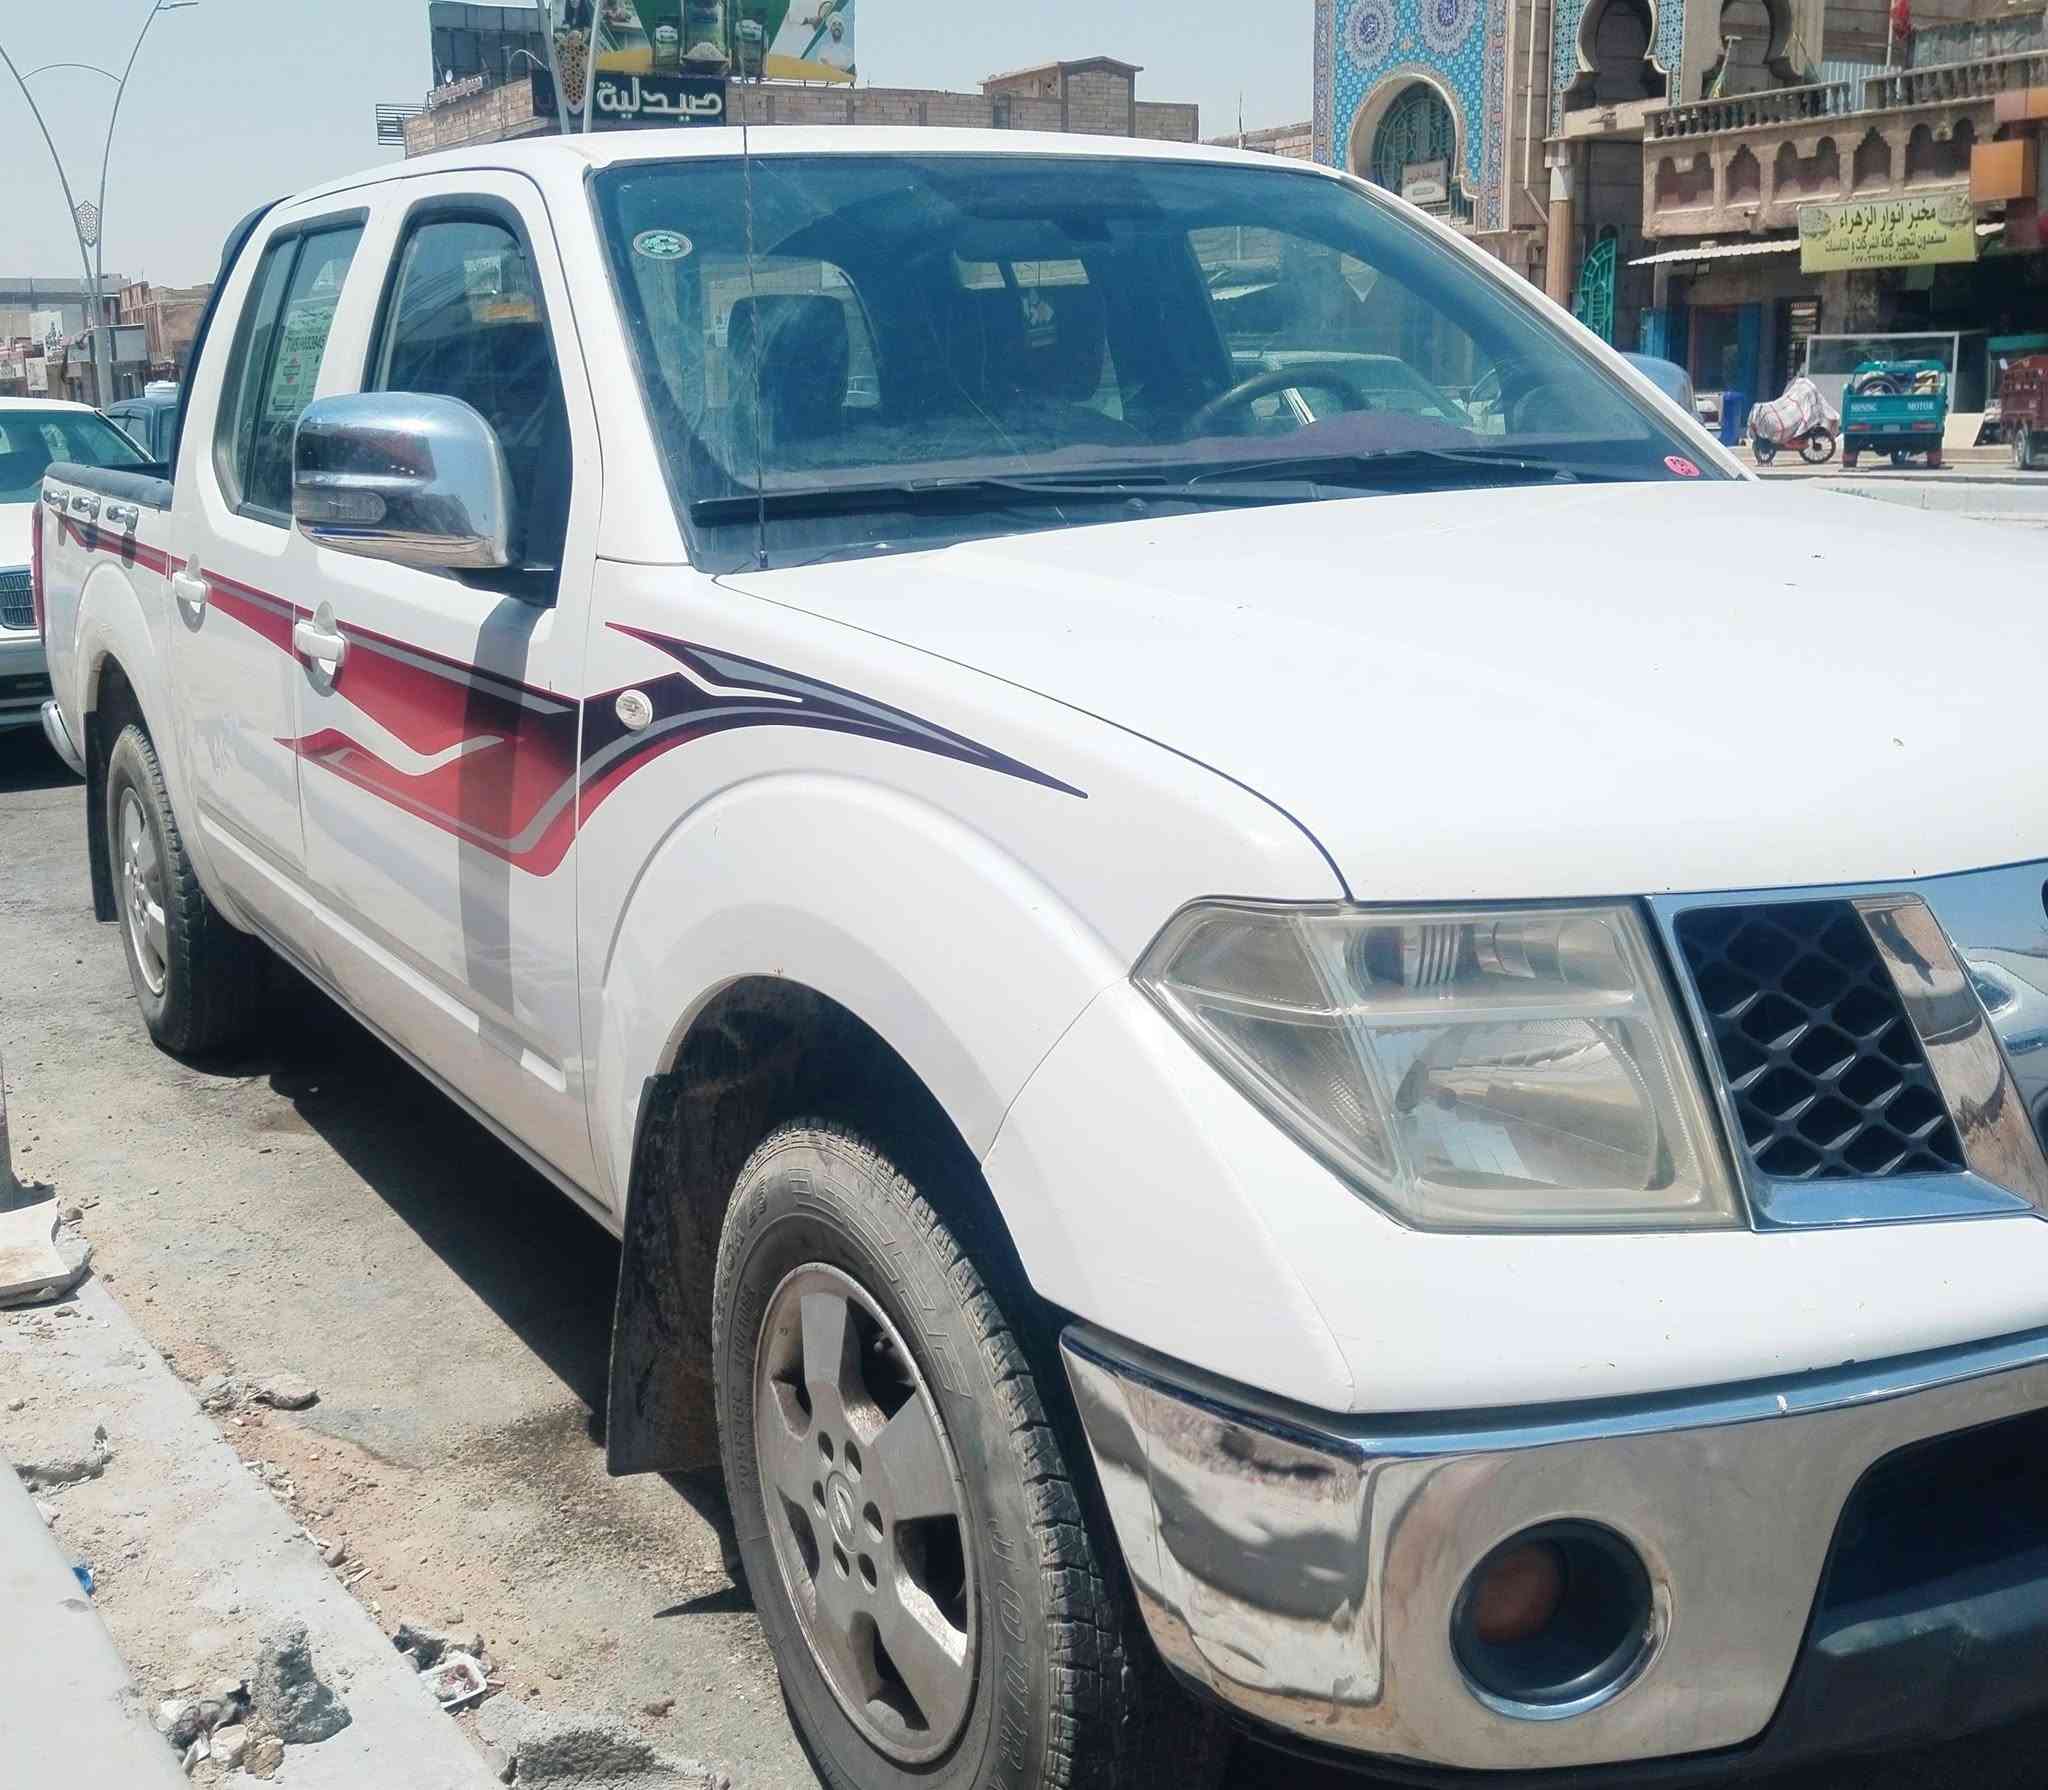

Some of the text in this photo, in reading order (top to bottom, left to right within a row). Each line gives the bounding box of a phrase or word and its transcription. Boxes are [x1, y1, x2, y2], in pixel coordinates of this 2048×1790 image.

[597, 76, 722, 121] صيدلية
[1839, 199, 1936, 234] مخبز انوار الزهراء
[1907, 400, 1934, 411] MOTOR
